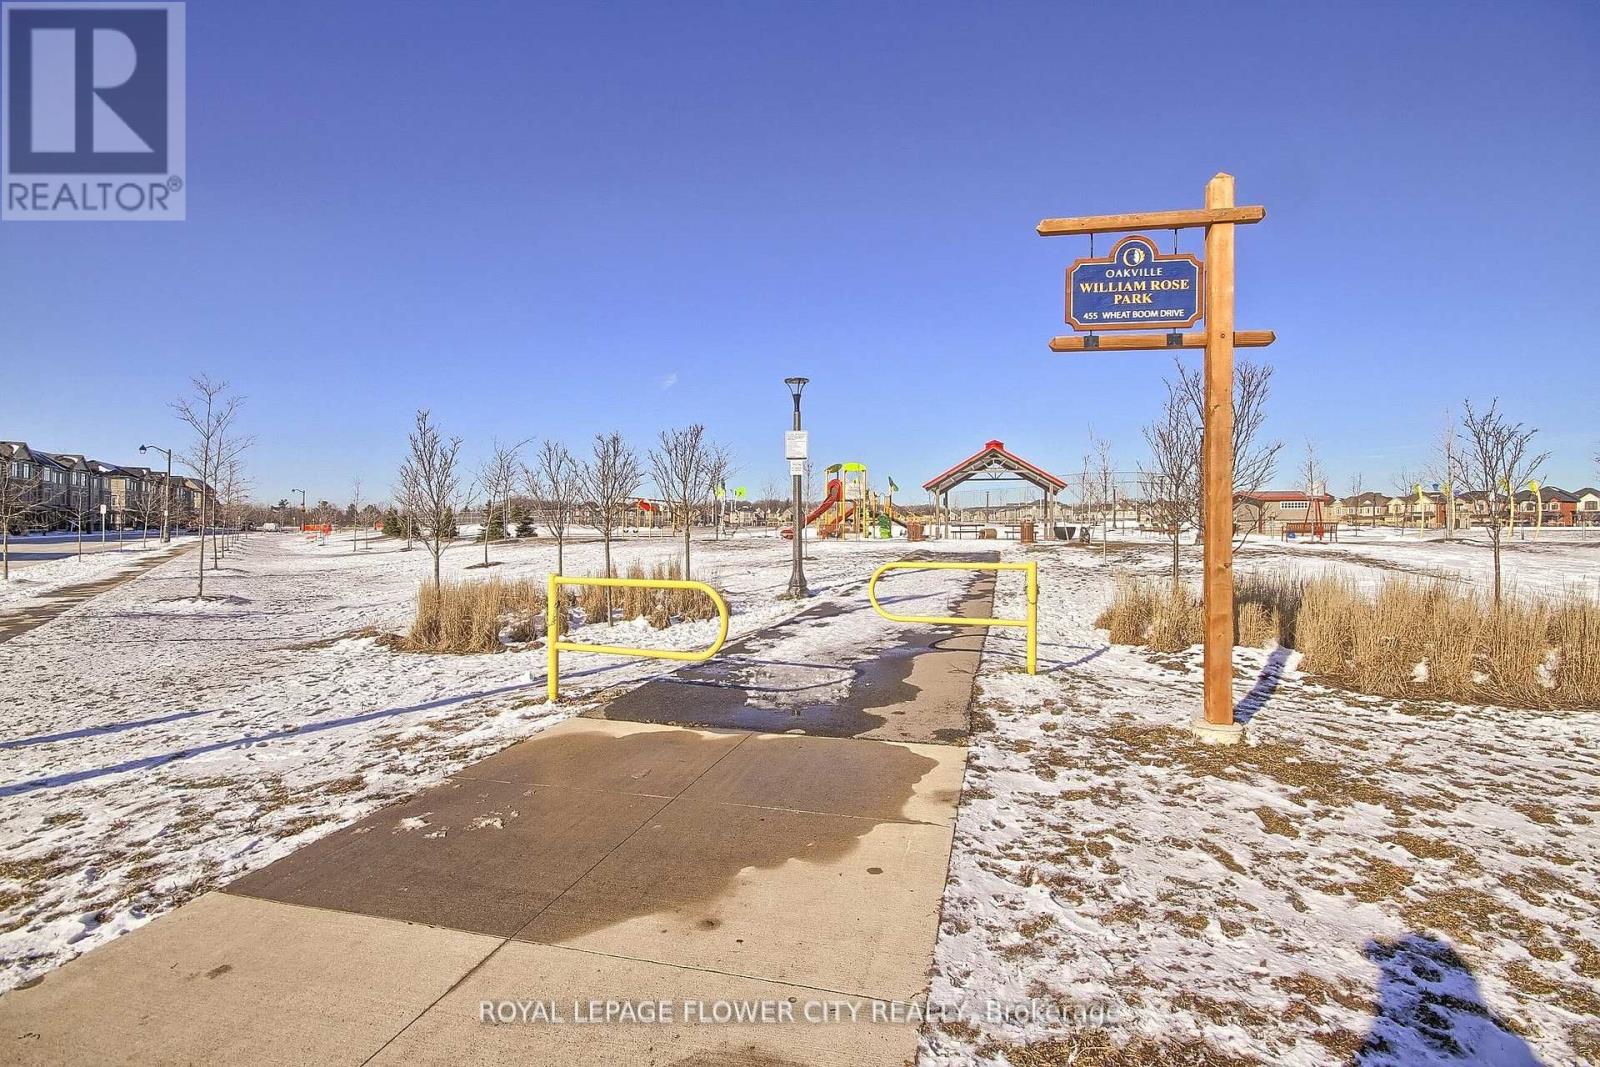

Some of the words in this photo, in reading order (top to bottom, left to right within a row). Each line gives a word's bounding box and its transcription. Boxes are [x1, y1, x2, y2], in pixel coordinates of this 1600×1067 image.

[1105, 267, 1163, 278] OAKVILLE
[1080, 280, 1147, 293] WILLIAM
[1150, 279, 1190, 291] ROSE
[1114, 293, 1153, 305] PARK
[1083, 312, 1098, 320] 455
[1102, 311, 1131, 319] WHEAT
[1132, 310, 1160, 318] BOOM
[1160, 309, 1185, 317] DRIVE
